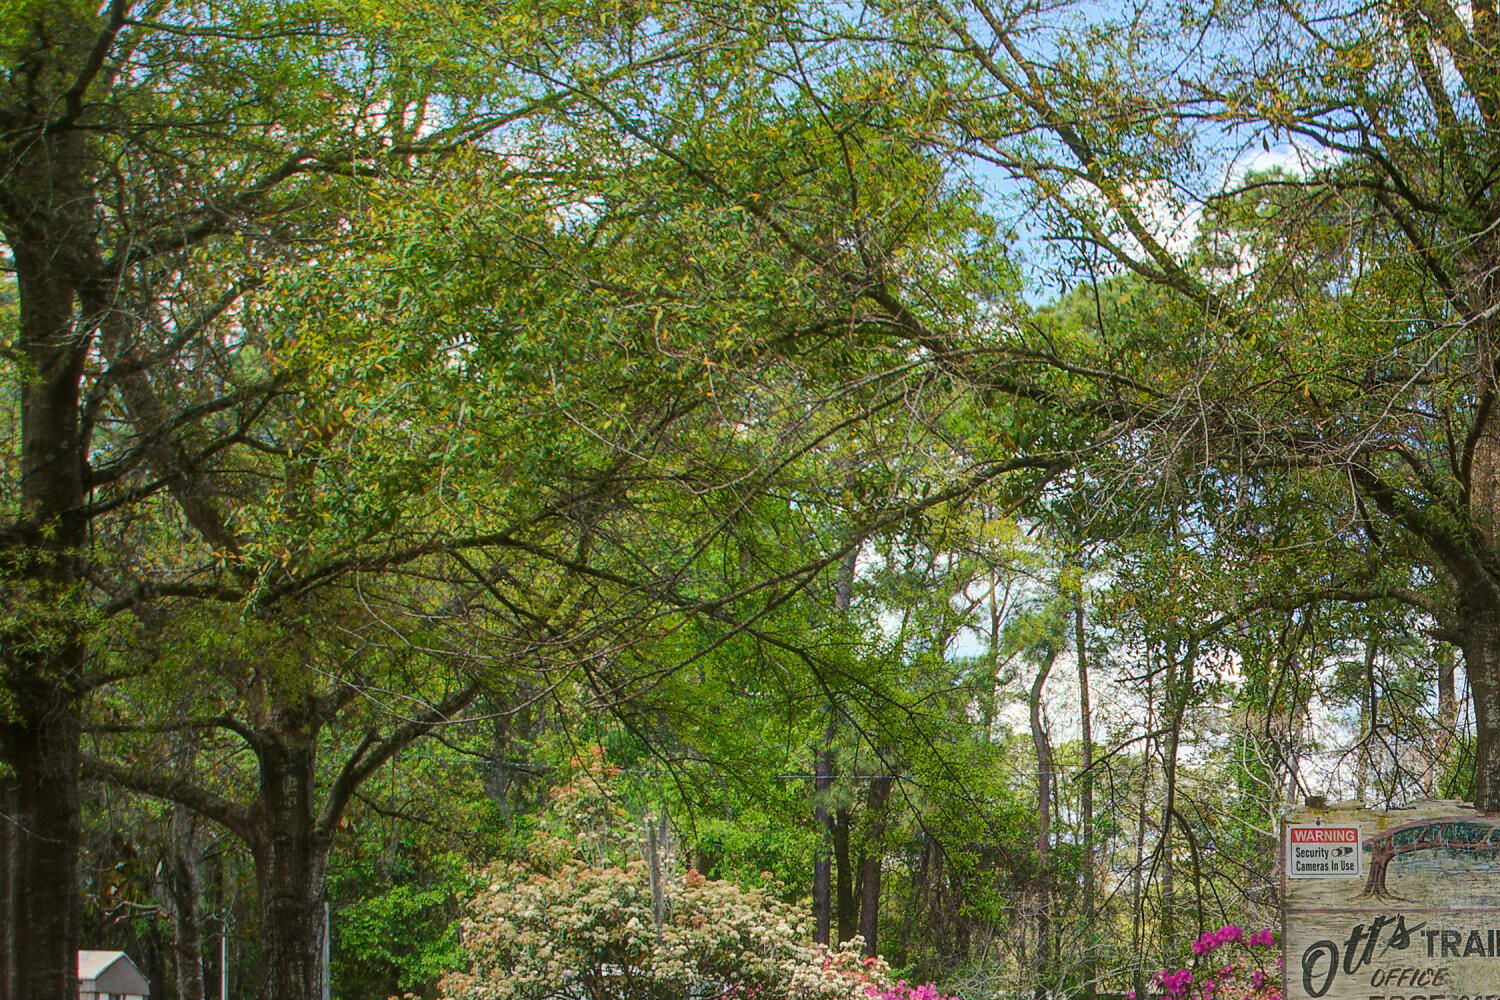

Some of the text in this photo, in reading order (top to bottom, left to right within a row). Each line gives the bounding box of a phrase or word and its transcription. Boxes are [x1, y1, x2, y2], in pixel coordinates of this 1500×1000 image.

[1295, 830, 1355, 841] WARNING
[1295, 847, 1329, 860] Security
[1295, 860, 1355, 872] Cameras In Use
[1302, 913, 1426, 998] Ott's
[1369, 966, 1448, 987] OFFICE
